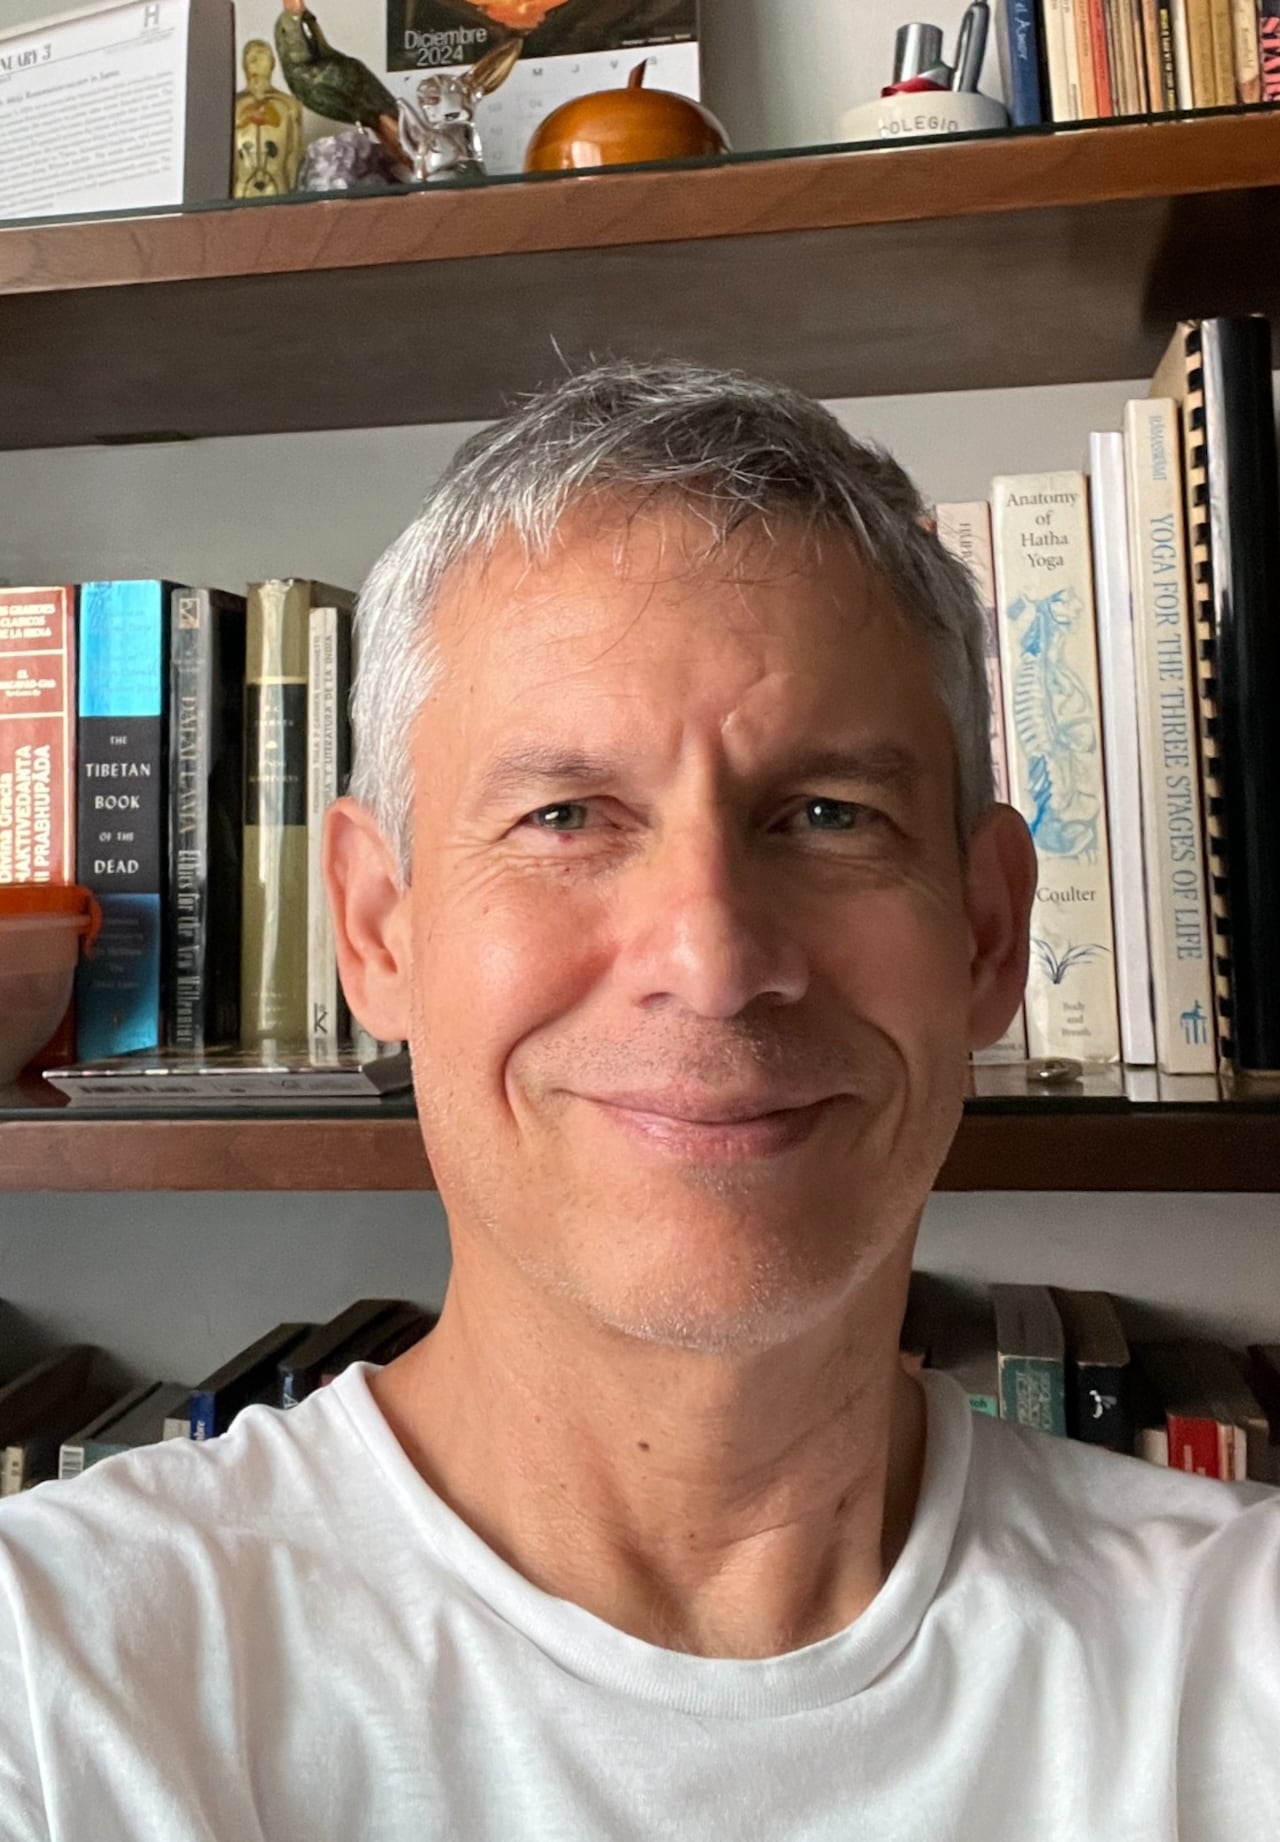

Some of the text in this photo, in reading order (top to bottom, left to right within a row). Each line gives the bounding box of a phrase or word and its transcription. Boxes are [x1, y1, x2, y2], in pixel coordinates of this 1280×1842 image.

[404, 25, 488, 50] Diciembre
[416, 45, 464, 66] 2024
[1006, 492, 1079, 508] Anatomy
[1035, 510, 1054, 525] of
[1021, 531, 1068, 547] Hatha
[1027, 553, 1064, 571] Yoga
[110, 736, 127, 745] THE
[1150, 513, 1202, 960] YOGA FOR THE THREE STAGES OF LIFE
[86, 763, 151, 778] TIBETAN
[95, 795, 140, 809] BOOK
[99, 832, 134, 841] OF THE
[94, 859, 139, 874] DEAD
[178, 850, 201, 888] Ethics
[178, 892, 201, 912] for
[1036, 886, 1096, 903] Coulter
[178, 916, 200, 936] the
[177, 945, 199, 969] New
[1067, 1014, 1084, 1024] and
